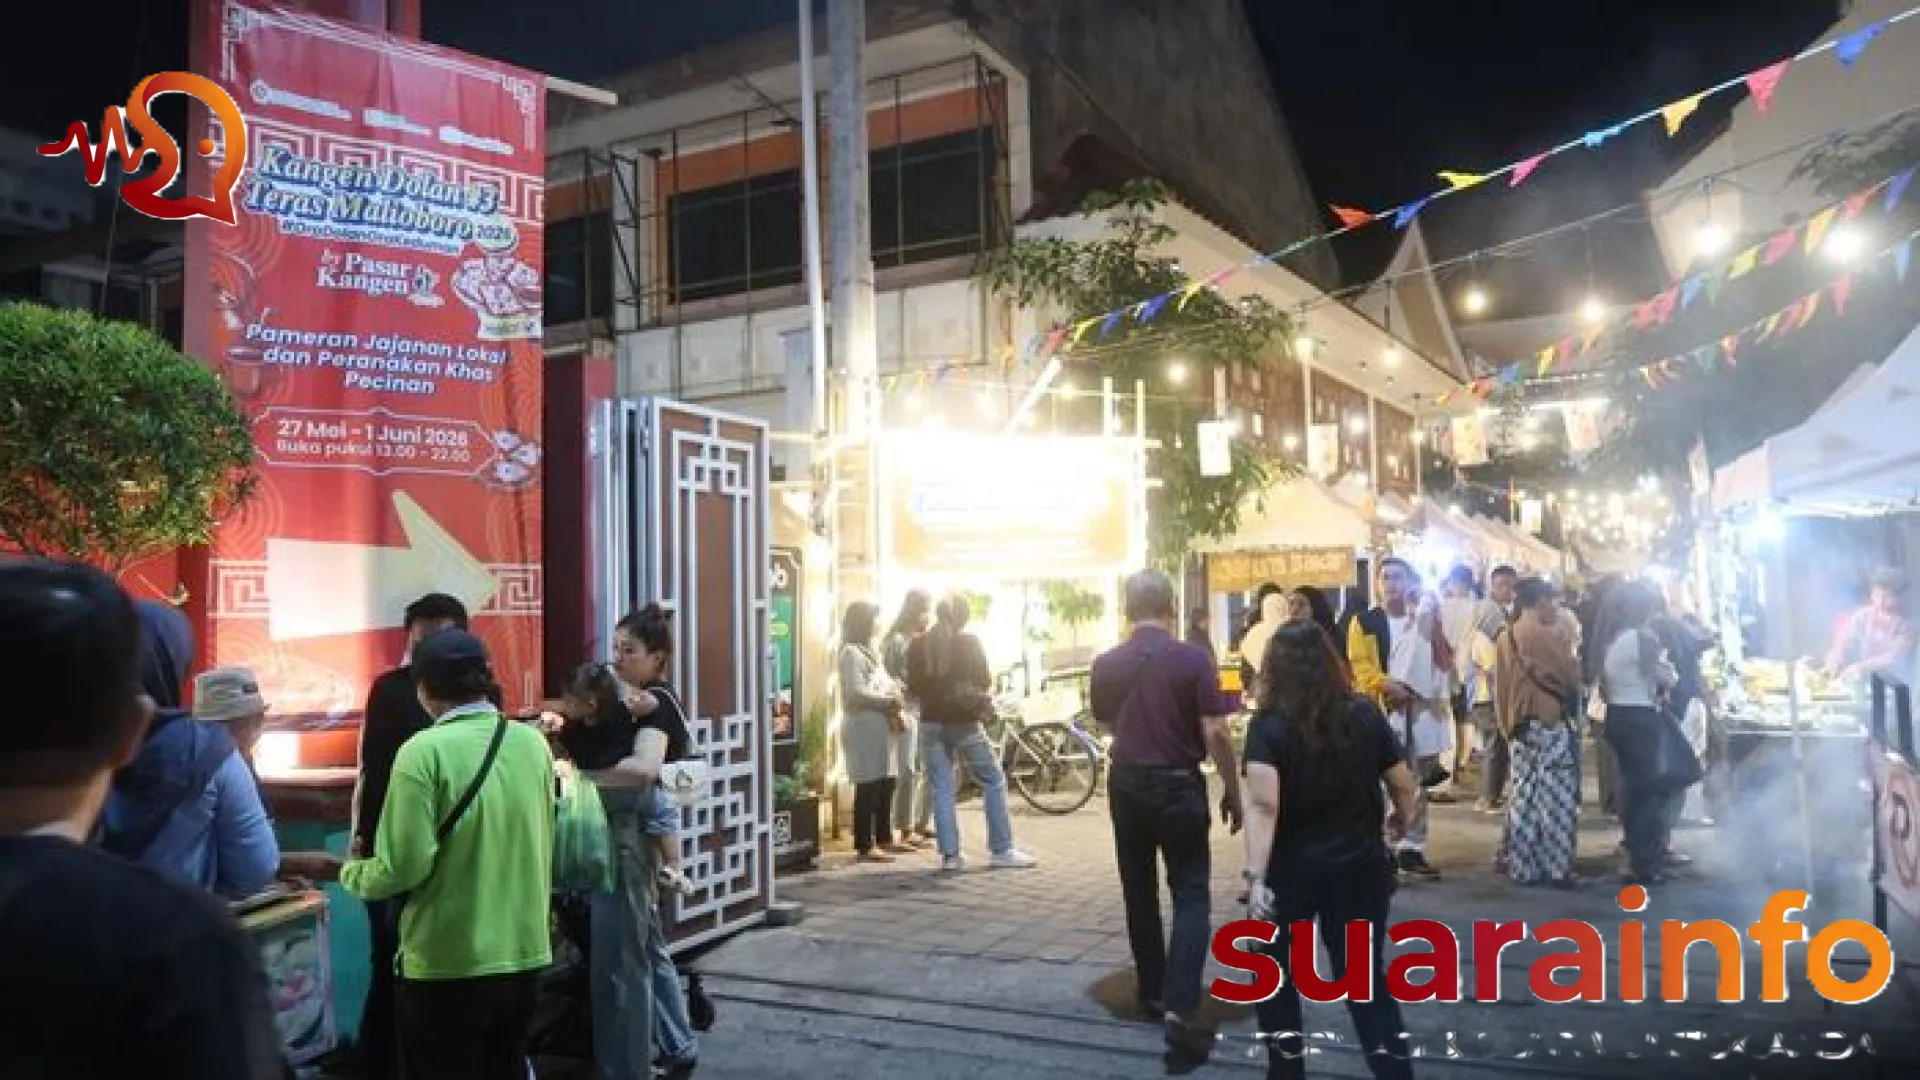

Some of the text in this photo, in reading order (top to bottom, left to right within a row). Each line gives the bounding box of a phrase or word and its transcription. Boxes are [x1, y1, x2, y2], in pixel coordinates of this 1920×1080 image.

[260, 145, 376, 193] Kangen
[380, 164, 461, 206] Dolan
[247, 180, 326, 218] Teras
[328, 194, 473, 239] Malioboro
[346, 252, 412, 277] Pasar
[316, 267, 409, 295] Kangen
[246, 323, 358, 348] Pameran
[364, 333, 451, 359] Jajanan
[263, 348, 494, 382] dan Peranakan Khas
[344, 370, 436, 394] Pecinan
[276, 420, 302, 436] 27
[307, 421, 347, 439] Mei
[376, 424, 422, 443] Juni
[276, 439, 323, 454] Buka
